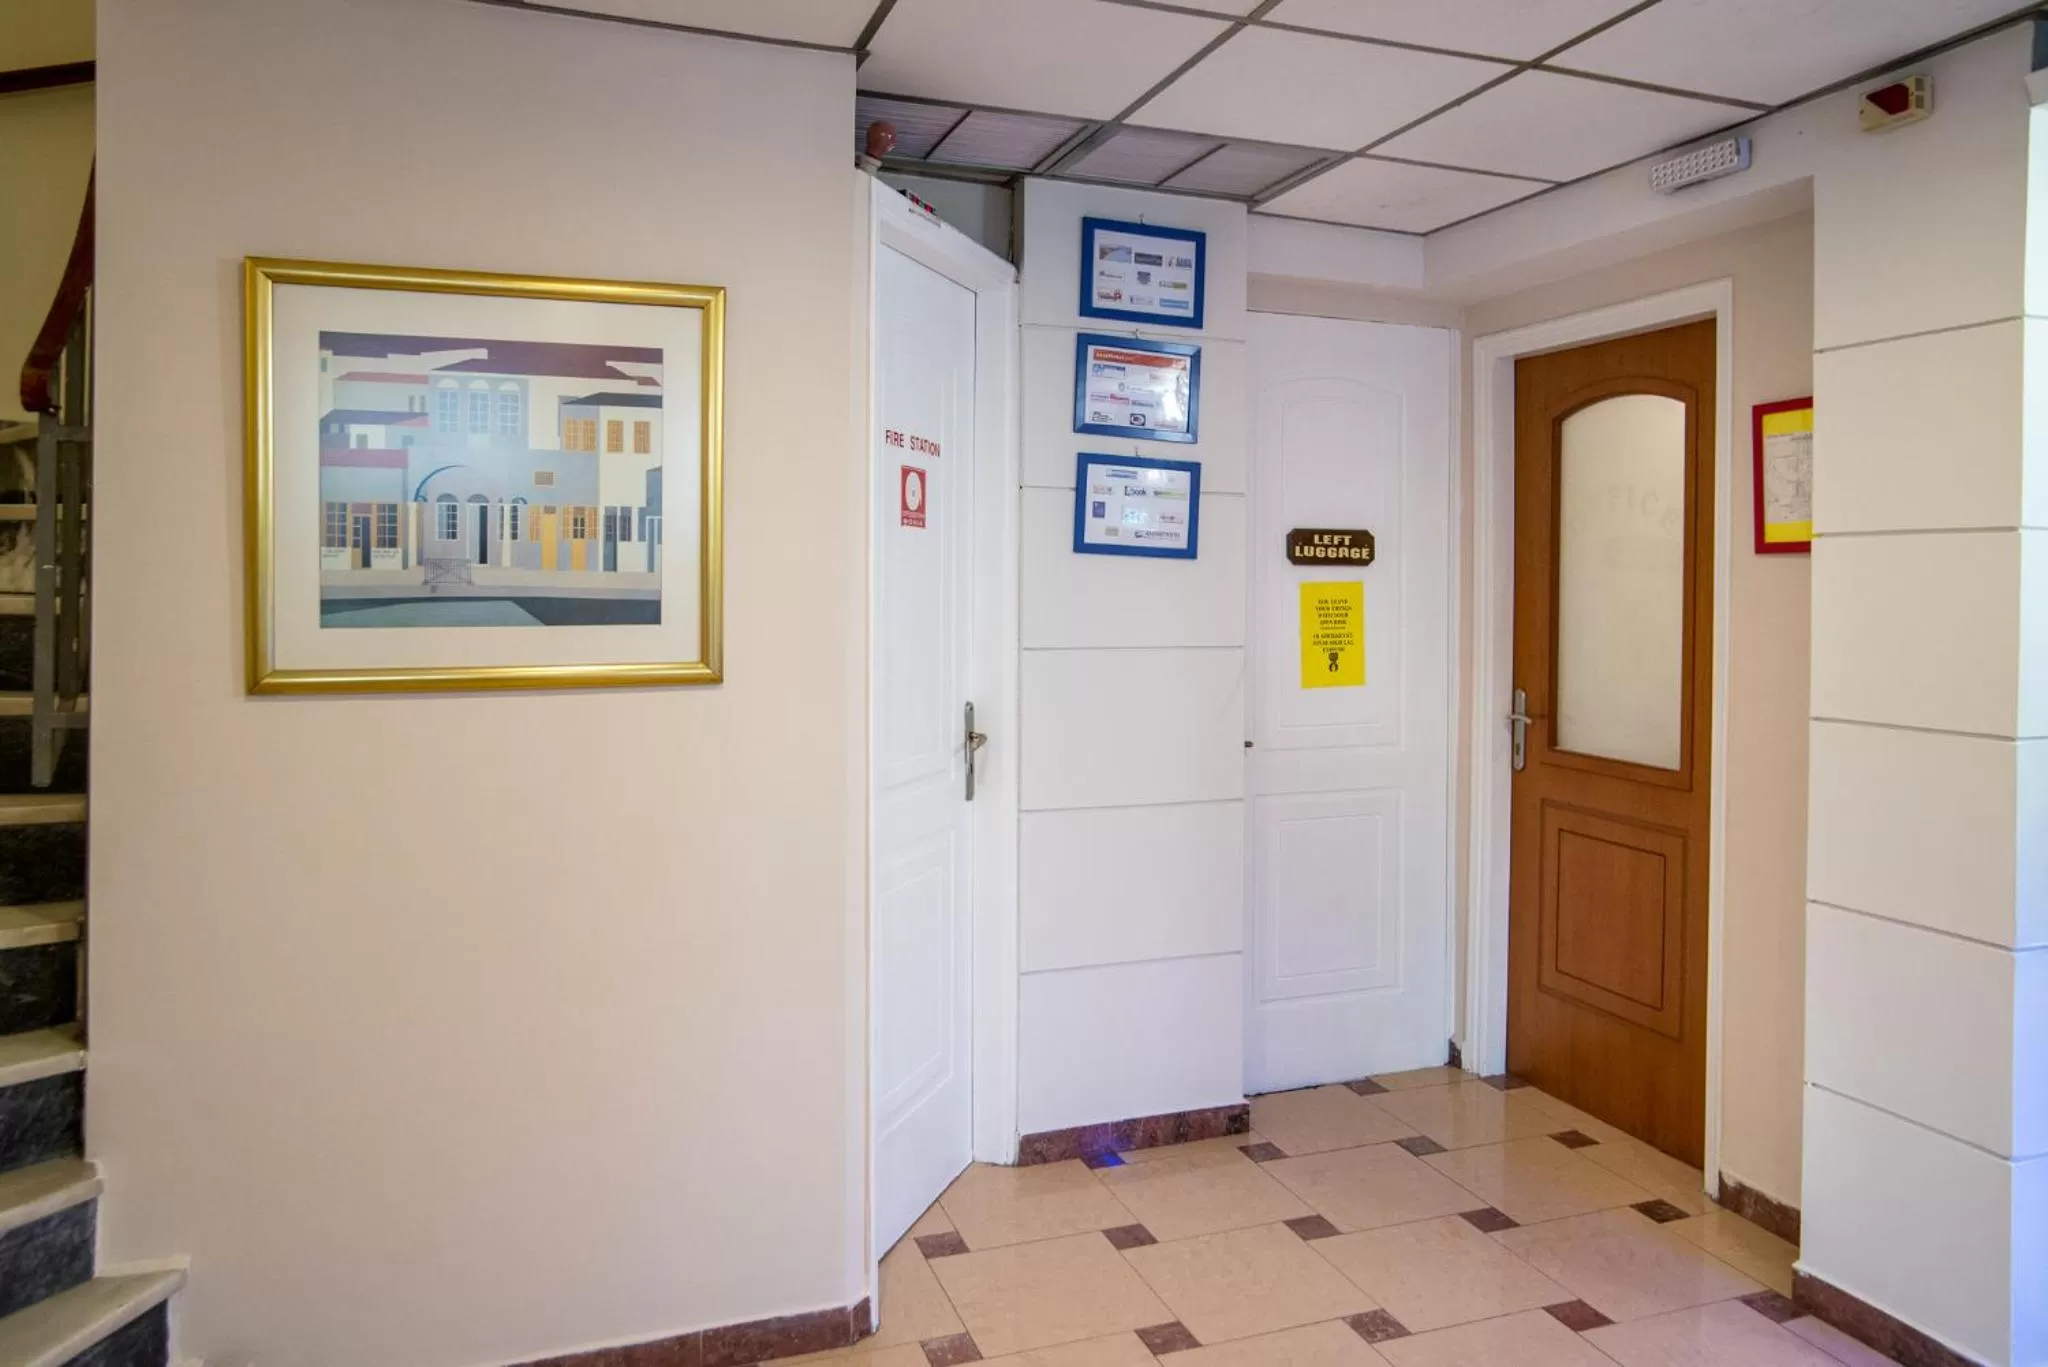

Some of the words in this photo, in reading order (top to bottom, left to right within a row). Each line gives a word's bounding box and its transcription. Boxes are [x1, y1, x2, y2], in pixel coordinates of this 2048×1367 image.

[885, 430, 904, 448] FIRE
[910, 435, 940, 457] STATION
[1313, 534, 1352, 546] LEFT
[1295, 545, 1370, 560] LUGGAGE
